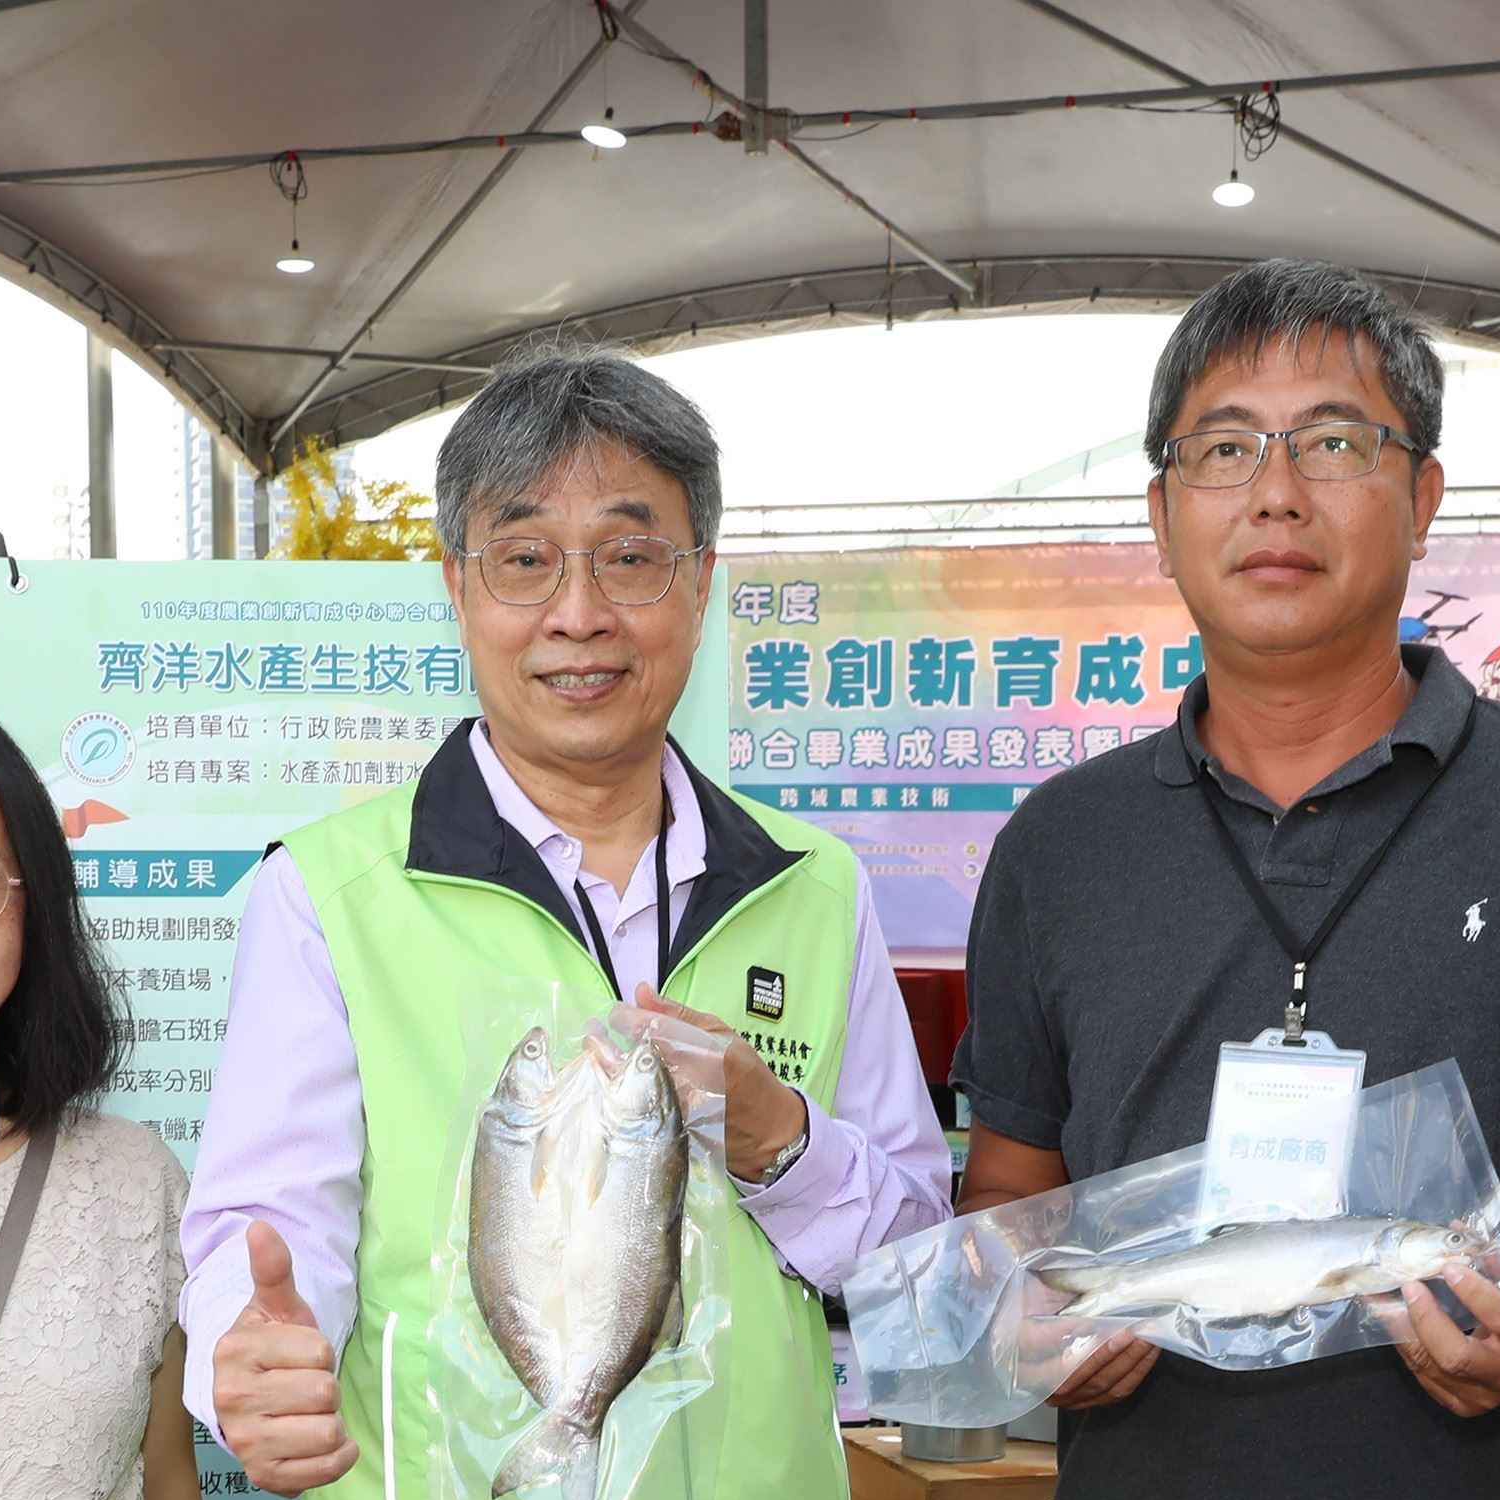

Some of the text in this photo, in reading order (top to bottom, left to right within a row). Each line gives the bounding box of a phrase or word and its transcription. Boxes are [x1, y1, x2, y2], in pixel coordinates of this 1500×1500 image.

[732, 582, 820, 624] 年度
[97, 641, 479, 693] 齊洋水產生技有
[89, 916, 242, 942] 協助規劃開發
[100, 1068, 218, 1093] 成率分別
[200, 1471, 261, 1495] 收穫
